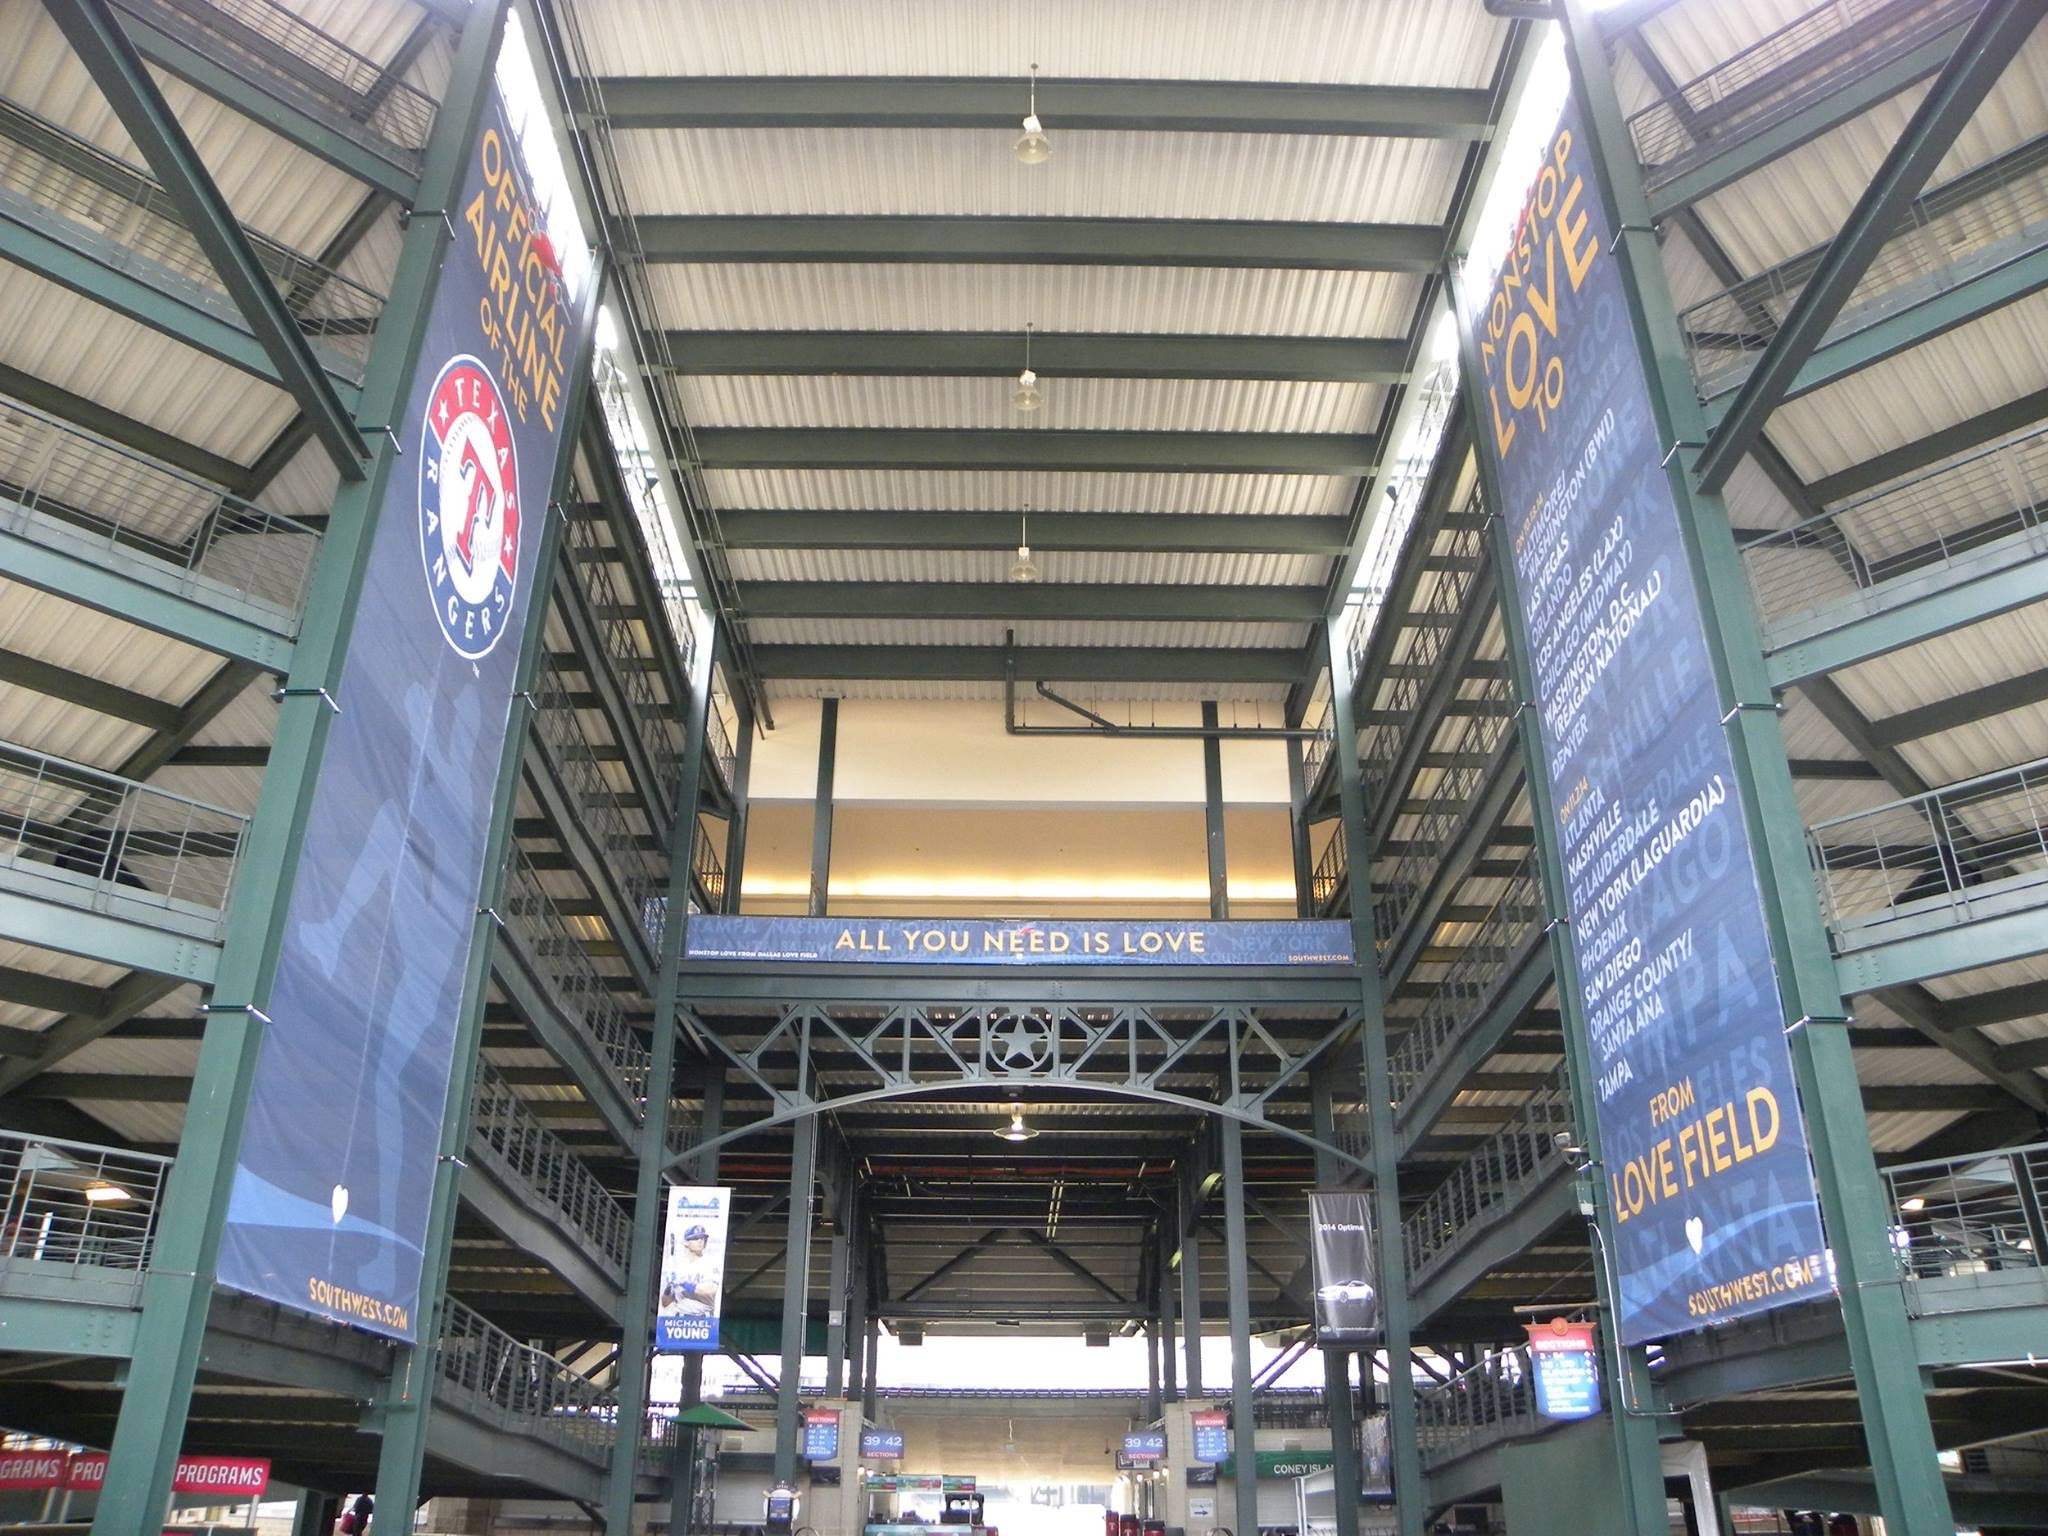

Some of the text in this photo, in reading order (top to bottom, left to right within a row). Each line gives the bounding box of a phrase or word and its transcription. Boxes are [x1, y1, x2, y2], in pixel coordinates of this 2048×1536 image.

[482, 128, 566, 376] OFFICIAL
[1481, 129, 1572, 375] NONSTOP
[465, 190, 561, 433] AIRLINE
[1490, 174, 1599, 460] LOVE
[480, 297, 528, 424] OF THE
[1533, 357, 1564, 432] TO
[454, 377, 515, 510] TEXAS
[1528, 462, 1585, 582] WASHINGTON
[1584, 408, 1615, 470] (BWI)
[427, 455, 505, 639] RANGERS
[1526, 531, 1569, 624] LAS VEGAS
[1531, 563, 1572, 647] ORLANDO
[1535, 636, 1552, 676] LOS
[1552, 565, 1593, 648] ANGELES
[1592, 515, 1623, 575] (LAX)
[1540, 624, 1580, 701] CHICAGO
[1579, 539, 1632, 633] (MIDWAY)
[1609, 581, 1635, 625] D.C.
[1554, 664, 1595, 741] (REAGAN
[1595, 570, 1661, 676] NATIONAL)
[1564, 785, 1605, 853] ATLANTA
[1568, 800, 1622, 883] NASHVILLE
[1572, 798, 1659, 914] FT. LAUDERDALE
[1577, 902, 1600, 945] NEW
[1598, 868, 1632, 917] YORK
[1630, 775, 1725, 884] (LAGUARDIA)
[800, 951, 818, 959] FIELD
[835, 929, 892, 952] ALL
[902, 930, 977, 952] YOU
[984, 930, 1070, 954] NEED
[1084, 932, 1110, 954] IS
[1123, 932, 1206, 954] LOVE
[1581, 910, 1628, 971] PHOENIX
[1584, 936, 1641, 1009] SAN DIEGO
[1590, 982, 1632, 1040] ORANGE
[1600, 992, 1665, 1061] SANTA ANA
[1598, 1057, 1633, 1101] TAMPA
[1649, 1075, 1695, 1128] FROM
[1612, 1138, 1679, 1224] LOVE
[1679, 1086, 1781, 1187] FIELD
[1318, 1223, 1364, 1232] 2014 Optima
[308, 1277, 408, 1330] SOUTHWEST.COM
[665, 1319, 711, 1328] MICHAEL
[1688, 1261, 1814, 1317] SOUTHWEST.COM
[666, 1327, 710, 1340] YOUNG
[0, 1459, 104, 1481] GRAMS PRO
[175, 1464, 263, 1487] PROGRAMS
[863, 1436, 902, 1446] 39 42
[1124, 1438, 1163, 1448] 39 42
[1273, 1464, 1307, 1474] CONEY
